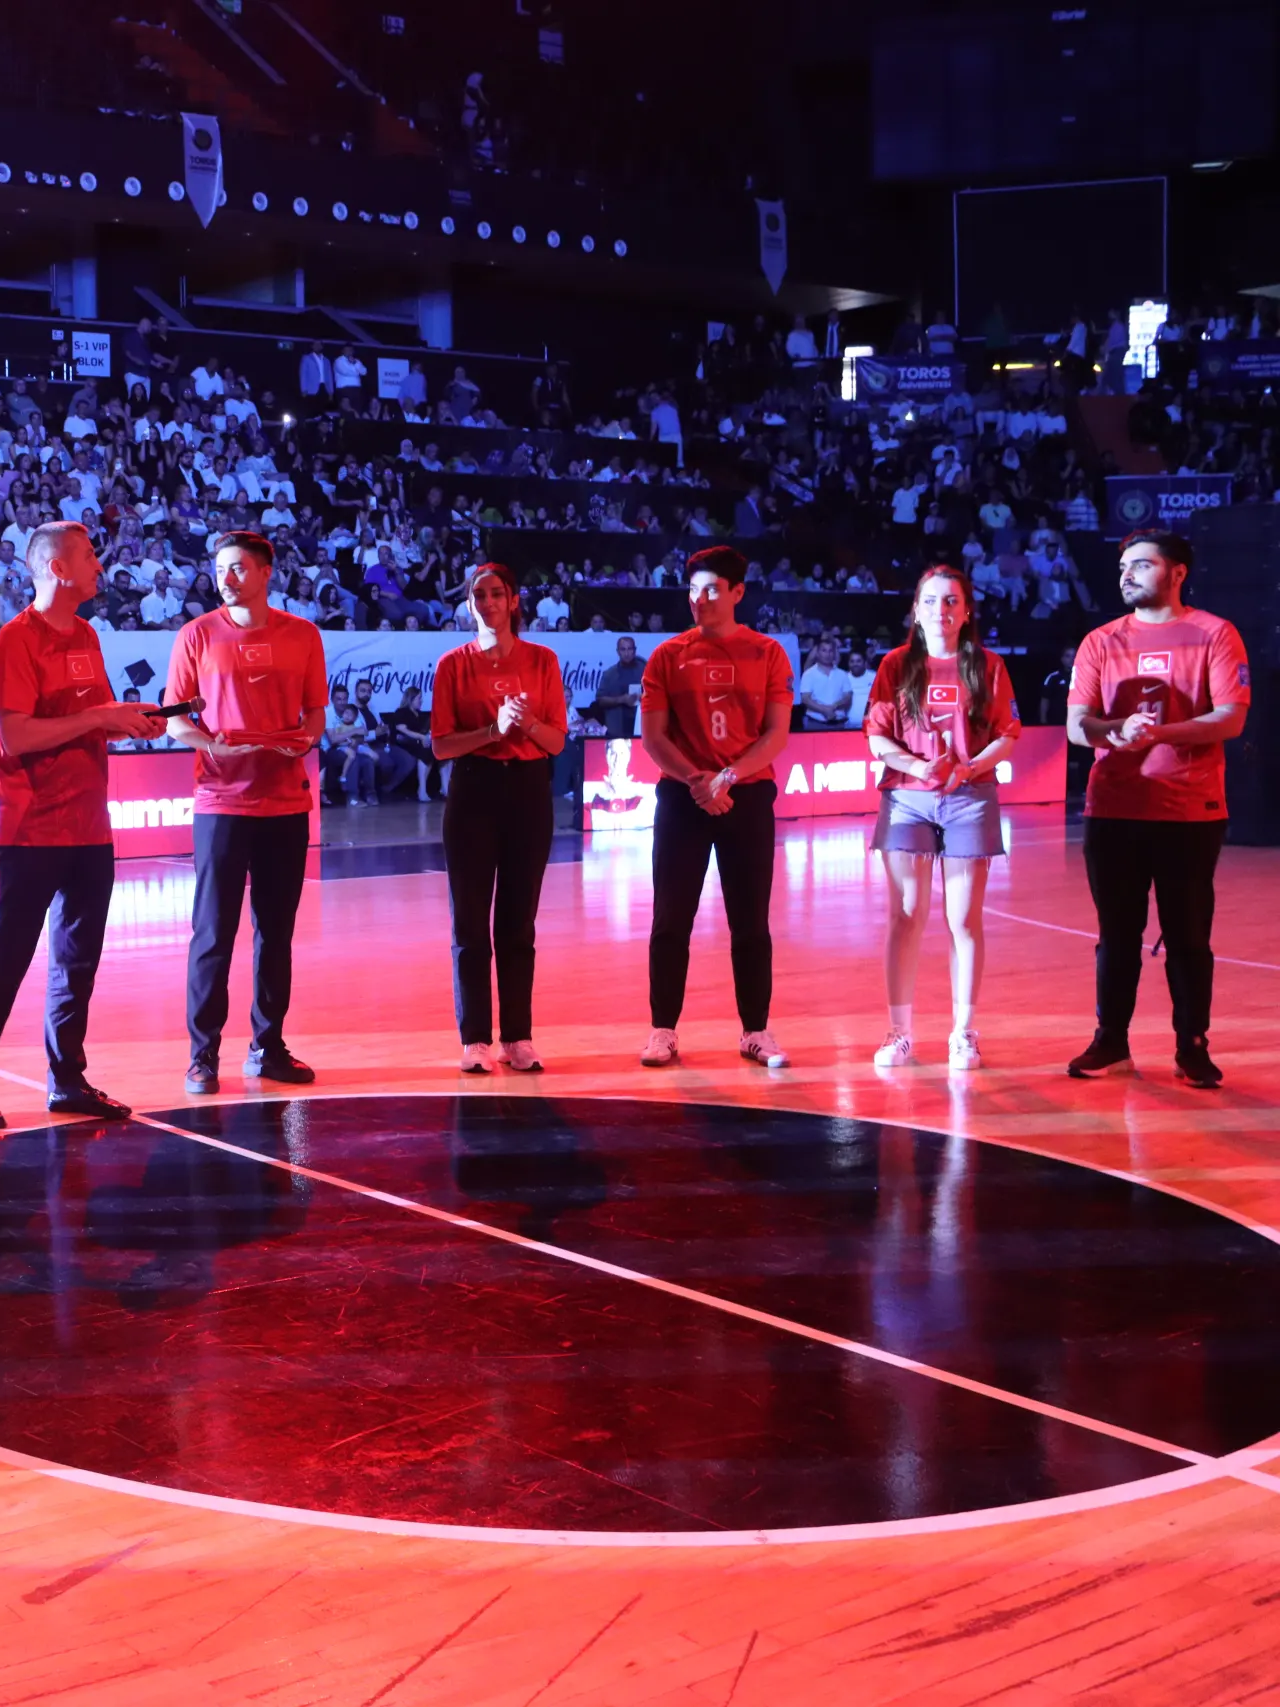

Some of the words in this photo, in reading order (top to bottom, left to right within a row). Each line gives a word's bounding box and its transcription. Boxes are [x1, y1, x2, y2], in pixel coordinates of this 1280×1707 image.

[74, 340, 89, 351] S-1
[92, 342, 108, 352] VIP
[78, 357, 104, 367] BLOK
[897, 366, 951, 380] TOROS
[1157, 492, 1221, 507] TOROS
[711, 710, 727, 740] 8
[785, 764, 810, 794] A
